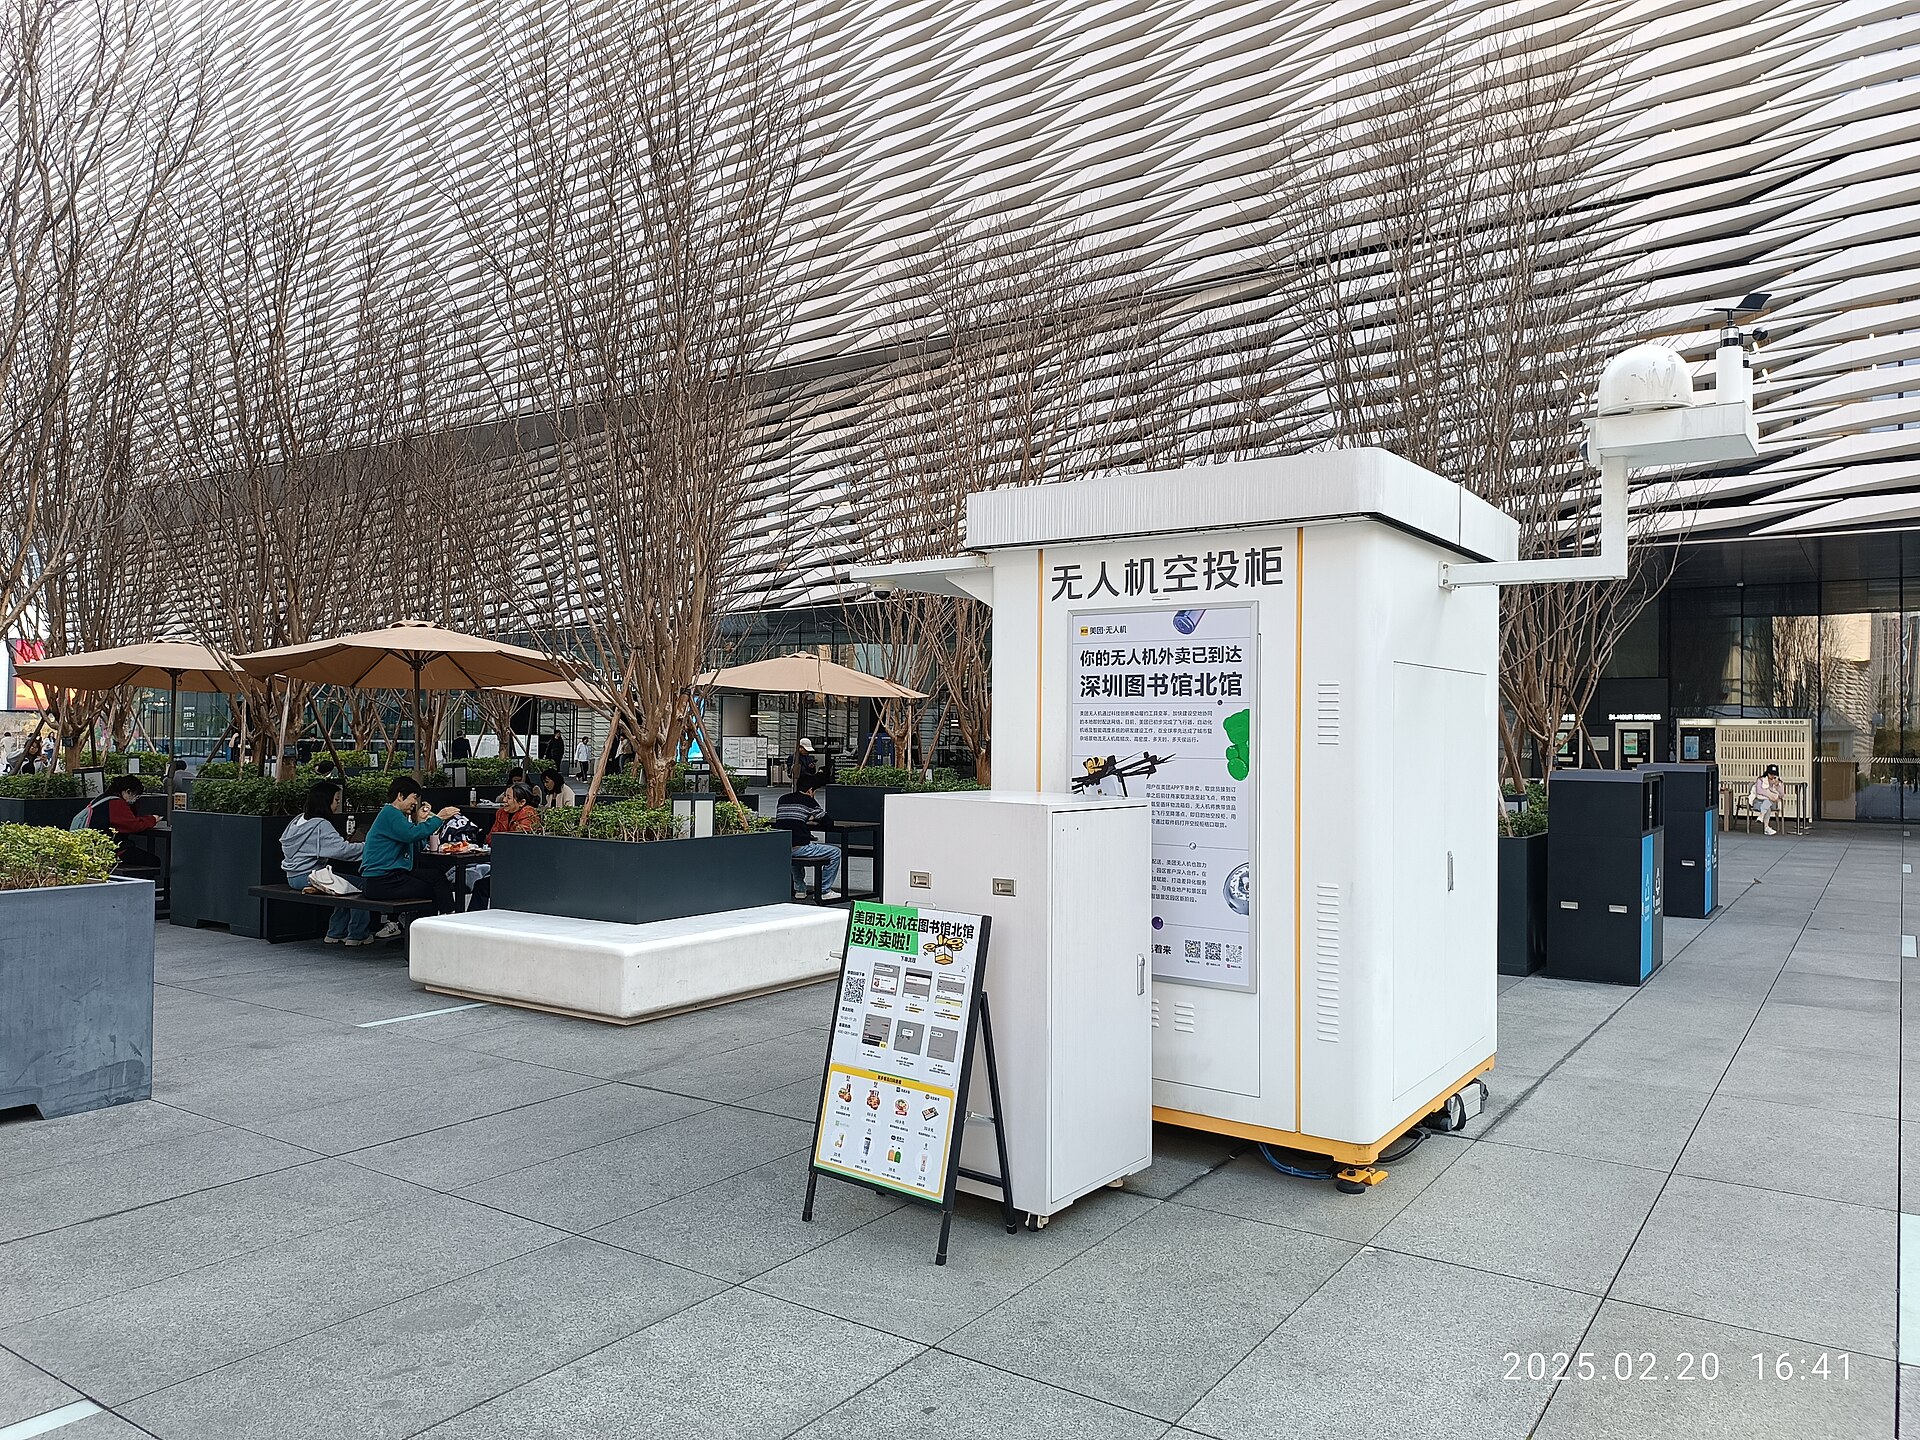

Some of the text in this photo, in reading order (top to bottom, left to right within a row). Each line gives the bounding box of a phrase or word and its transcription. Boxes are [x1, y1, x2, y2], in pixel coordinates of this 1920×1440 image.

[1051, 546, 1283, 601] 无人机空投柜
[1080, 645, 1242, 667] 你的无人机外卖已到达
[1080, 672, 1242, 698] 深圳图书馆北馆
[854, 910, 974, 940] 美团无人机在图书馆北馆
